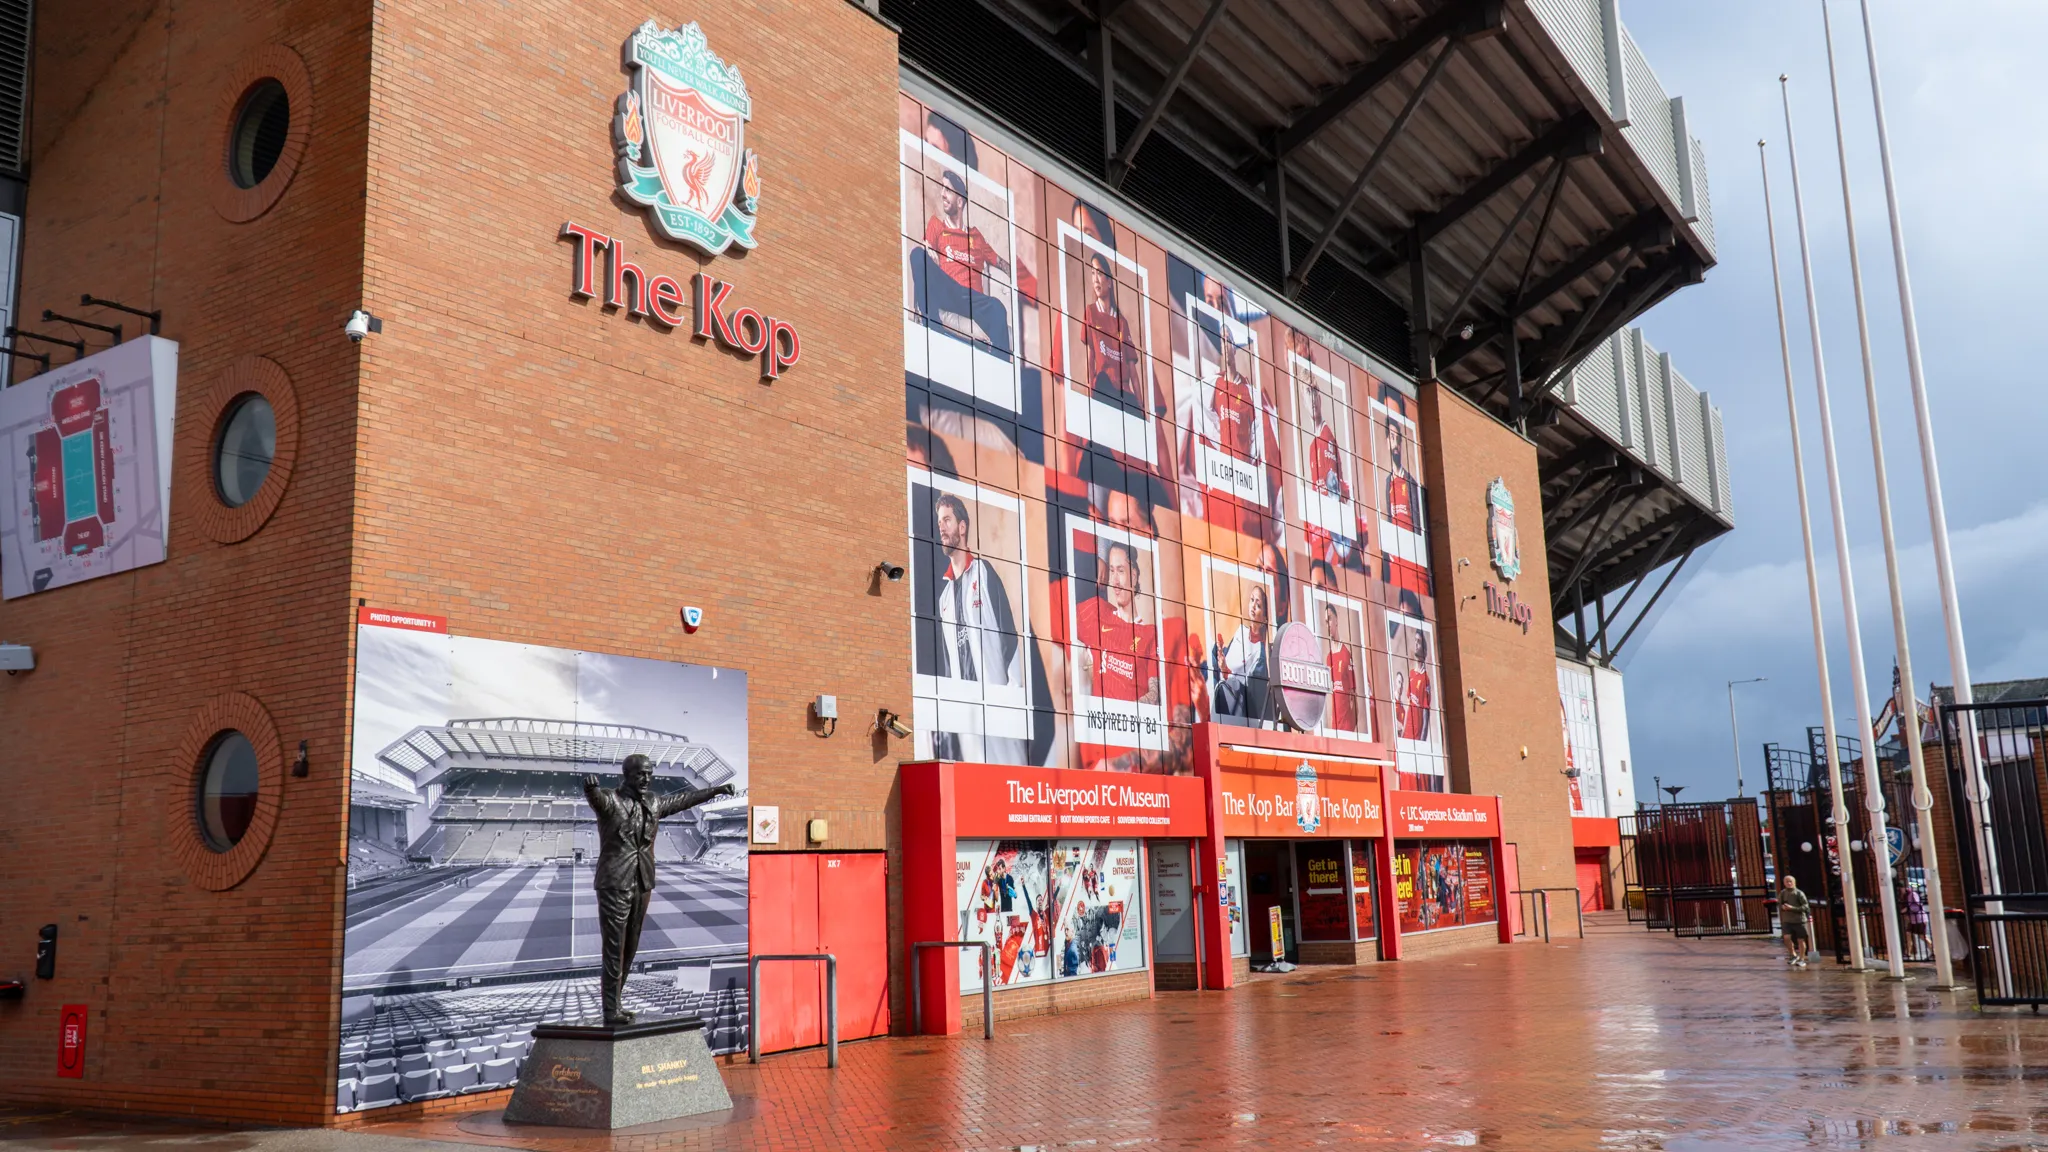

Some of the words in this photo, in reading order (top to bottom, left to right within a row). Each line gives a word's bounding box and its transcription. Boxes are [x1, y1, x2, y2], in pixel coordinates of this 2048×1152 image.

[638, 46, 667, 70] YOU'LL
[667, 64, 694, 85] NEVER
[695, 78, 718, 98] WALK
[720, 90, 747, 111] ALONE
[653, 88, 734, 144] LIVERPOOL
[656, 111, 705, 145] FOOTBALL
[707, 136, 731, 157] CLUB
[564, 221, 686, 327] The
[697, 272, 801, 380] Kop
[1211, 459, 1219, 477] IL
[1219, 463, 1253, 491] CAPTANO
[1483, 581, 1510, 618] The
[1508, 590, 1533, 635] Kop
[370, 613, 390, 622] PHOTO
[391, 616, 432, 627] OPPORTUNITY
[432, 620, 436, 628] 1
[1107, 663, 1133, 680] chartered
[1108, 655, 1133, 670] standard
[1281, 660, 1305, 685] BOOT
[1306, 665, 1331, 690] ROOM
[1087, 710, 1128, 732] INSPIRED
[1130, 715, 1140, 734] BY
[1006, 780, 1034, 804] The
[1037, 782, 1099, 811] Liverpool
[1101, 785, 1117, 806] FC
[1119, 786, 1171, 808] Museum
[1222, 792, 1246, 815] The
[1248, 793, 1272, 822] Kop
[1275, 795, 1293, 817] Bar
[1321, 797, 1340, 818] The
[1342, 798, 1362, 824] Kop
[1364, 799, 1380, 819] Bar
[1406, 806, 1418, 821] LFC
[1418, 806, 1447, 824] Superstore
[1447, 807, 1453, 822] &
[1452, 807, 1473, 822] Stadium
[1473, 808, 1487, 823] Tours
[1008, 814, 1028, 823] MUSEUM
[1029, 814, 1052, 823] ENTRANCE
[1060, 815, 1071, 823] BOOT
[1072, 815, 1084, 823] ROOM
[1149, 816, 1170, 825] COLLECTION
[956, 861, 970, 870] DIUM
[1112, 866, 1135, 875] ENTRANCE
[1115, 857, 1135, 866] MUSEUM
[1308, 859, 1326, 871] Get
[1327, 858, 1337, 871] in
[1309, 871, 1338, 883] there!
[1397, 876, 1413, 899] ere!
[551, 1064, 582, 1080] Carlsberg
[641, 1065, 655, 1074] BILL
[657, 1059, 687, 1072] SHANKLY
